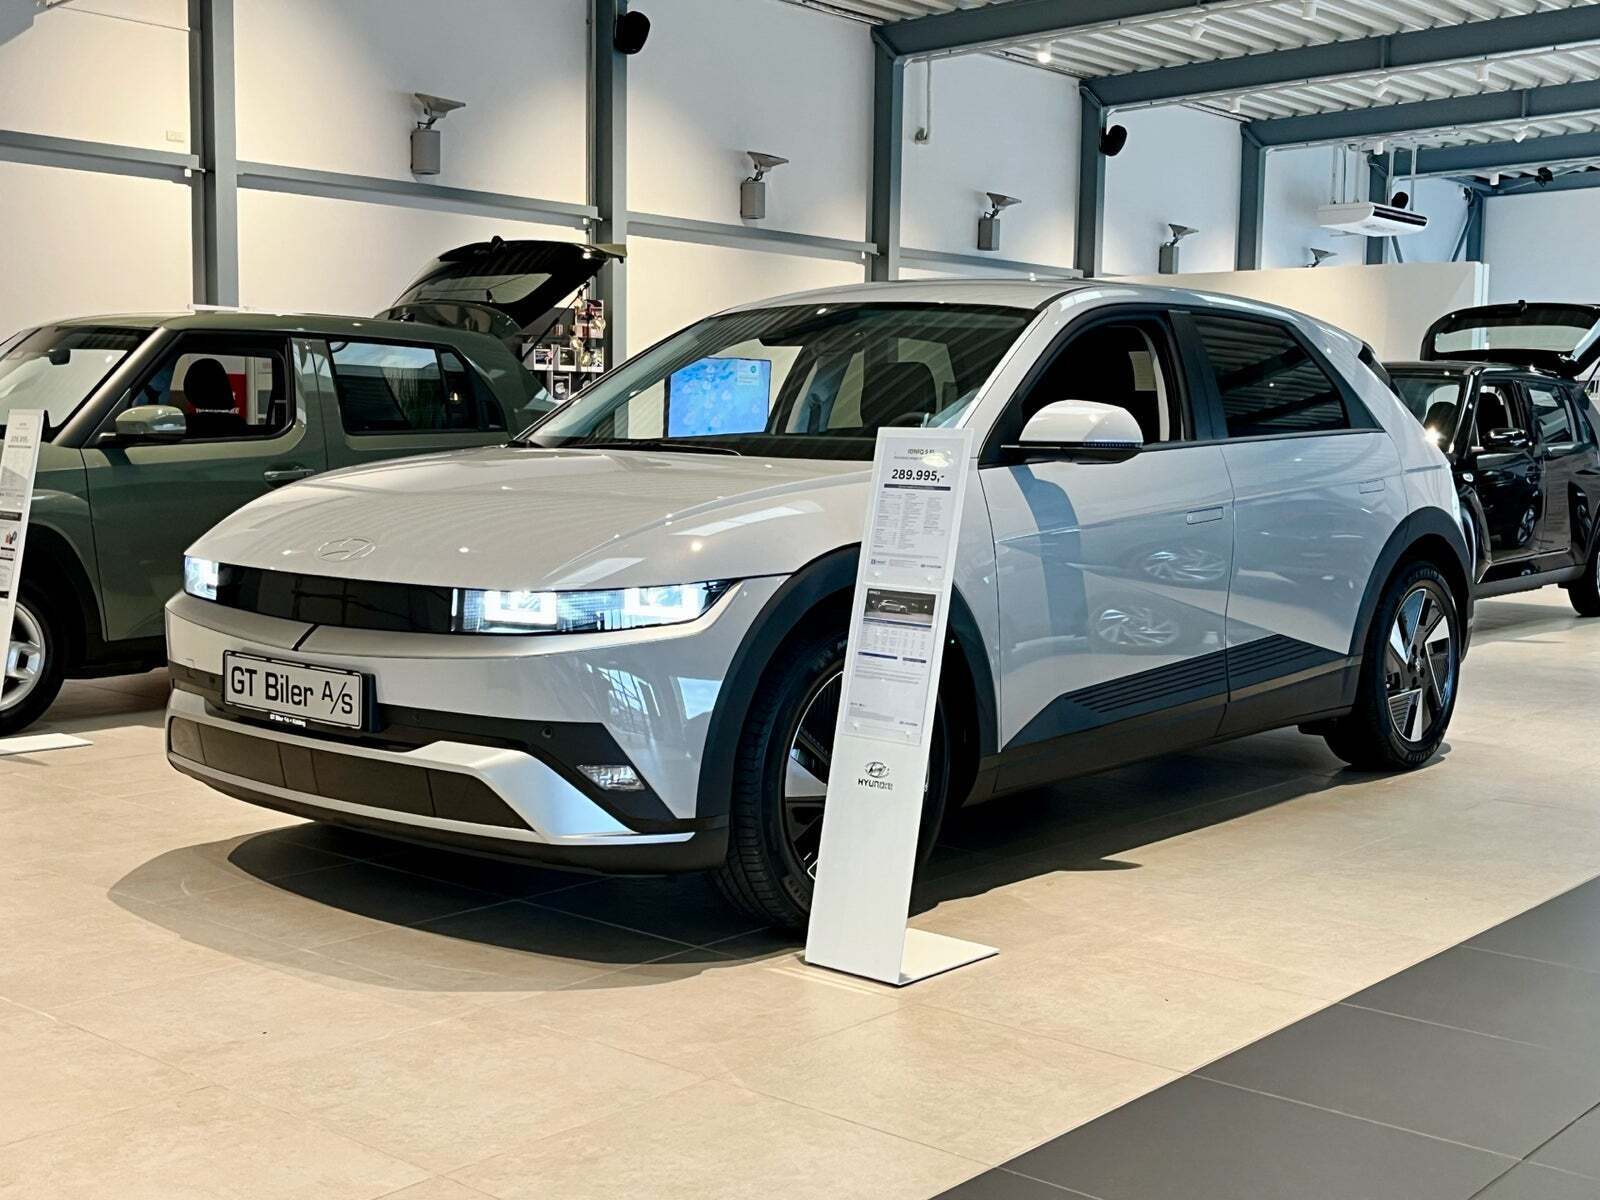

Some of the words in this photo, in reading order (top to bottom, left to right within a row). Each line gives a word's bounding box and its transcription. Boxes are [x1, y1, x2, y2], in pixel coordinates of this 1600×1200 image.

[892, 469, 944, 483] 289.995,-
[231, 666, 257, 696] GT
[265, 671, 314, 707] Biler
[321, 680, 353, 715] A/S
